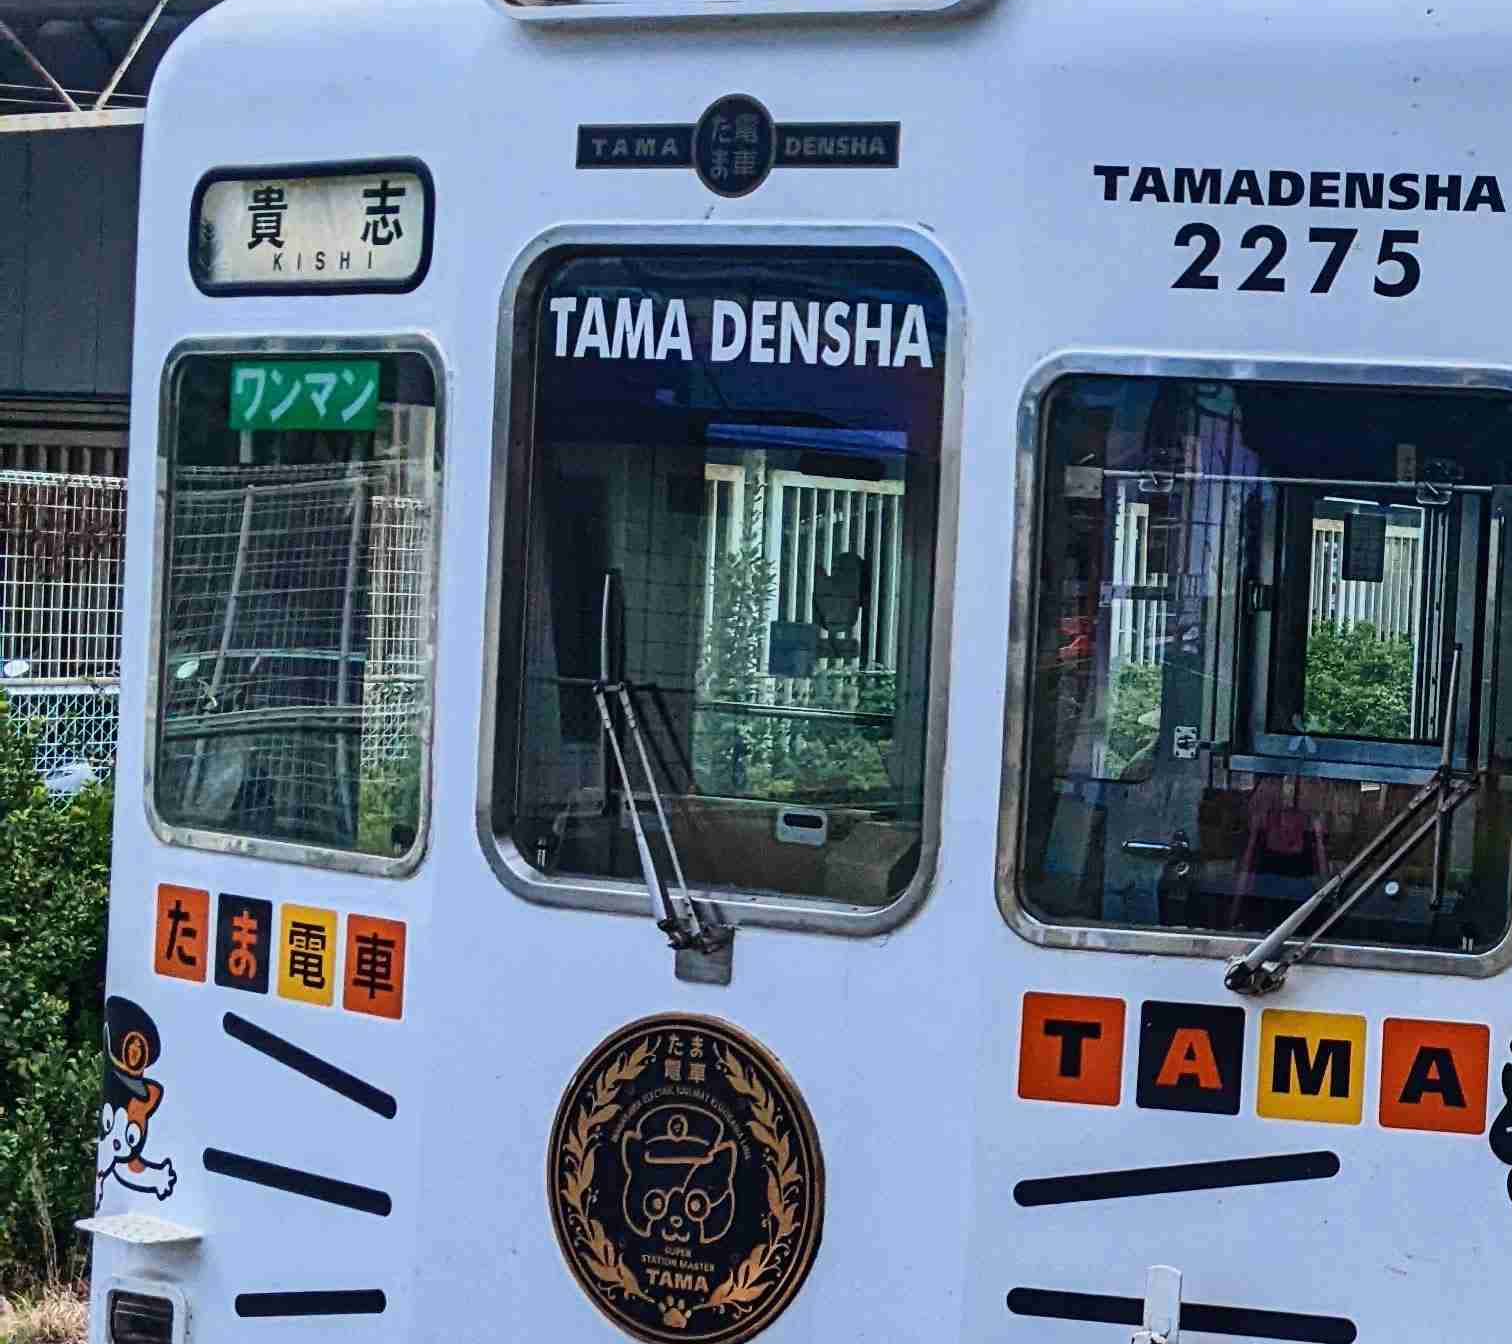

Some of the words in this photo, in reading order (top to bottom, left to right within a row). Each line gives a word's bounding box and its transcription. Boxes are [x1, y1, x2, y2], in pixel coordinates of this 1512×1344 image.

[591, 137, 679, 157] TAMA
[784, 135, 886, 156] DENSHA
[247, 179, 406, 249] 貴志
[1093, 164, 1506, 213] TAMADENSHA
[272, 251, 374, 272] KISHI
[1170, 222, 1421, 297] 2275
[550, 297, 694, 361] TAMA
[711, 300, 934, 368] DENSHA
[235, 367, 376, 423] ワンマン
[166, 899, 396, 999] たま電車
[1043, 1019, 1467, 1109] TAMA
[646, 1268, 709, 1292] TAMA
